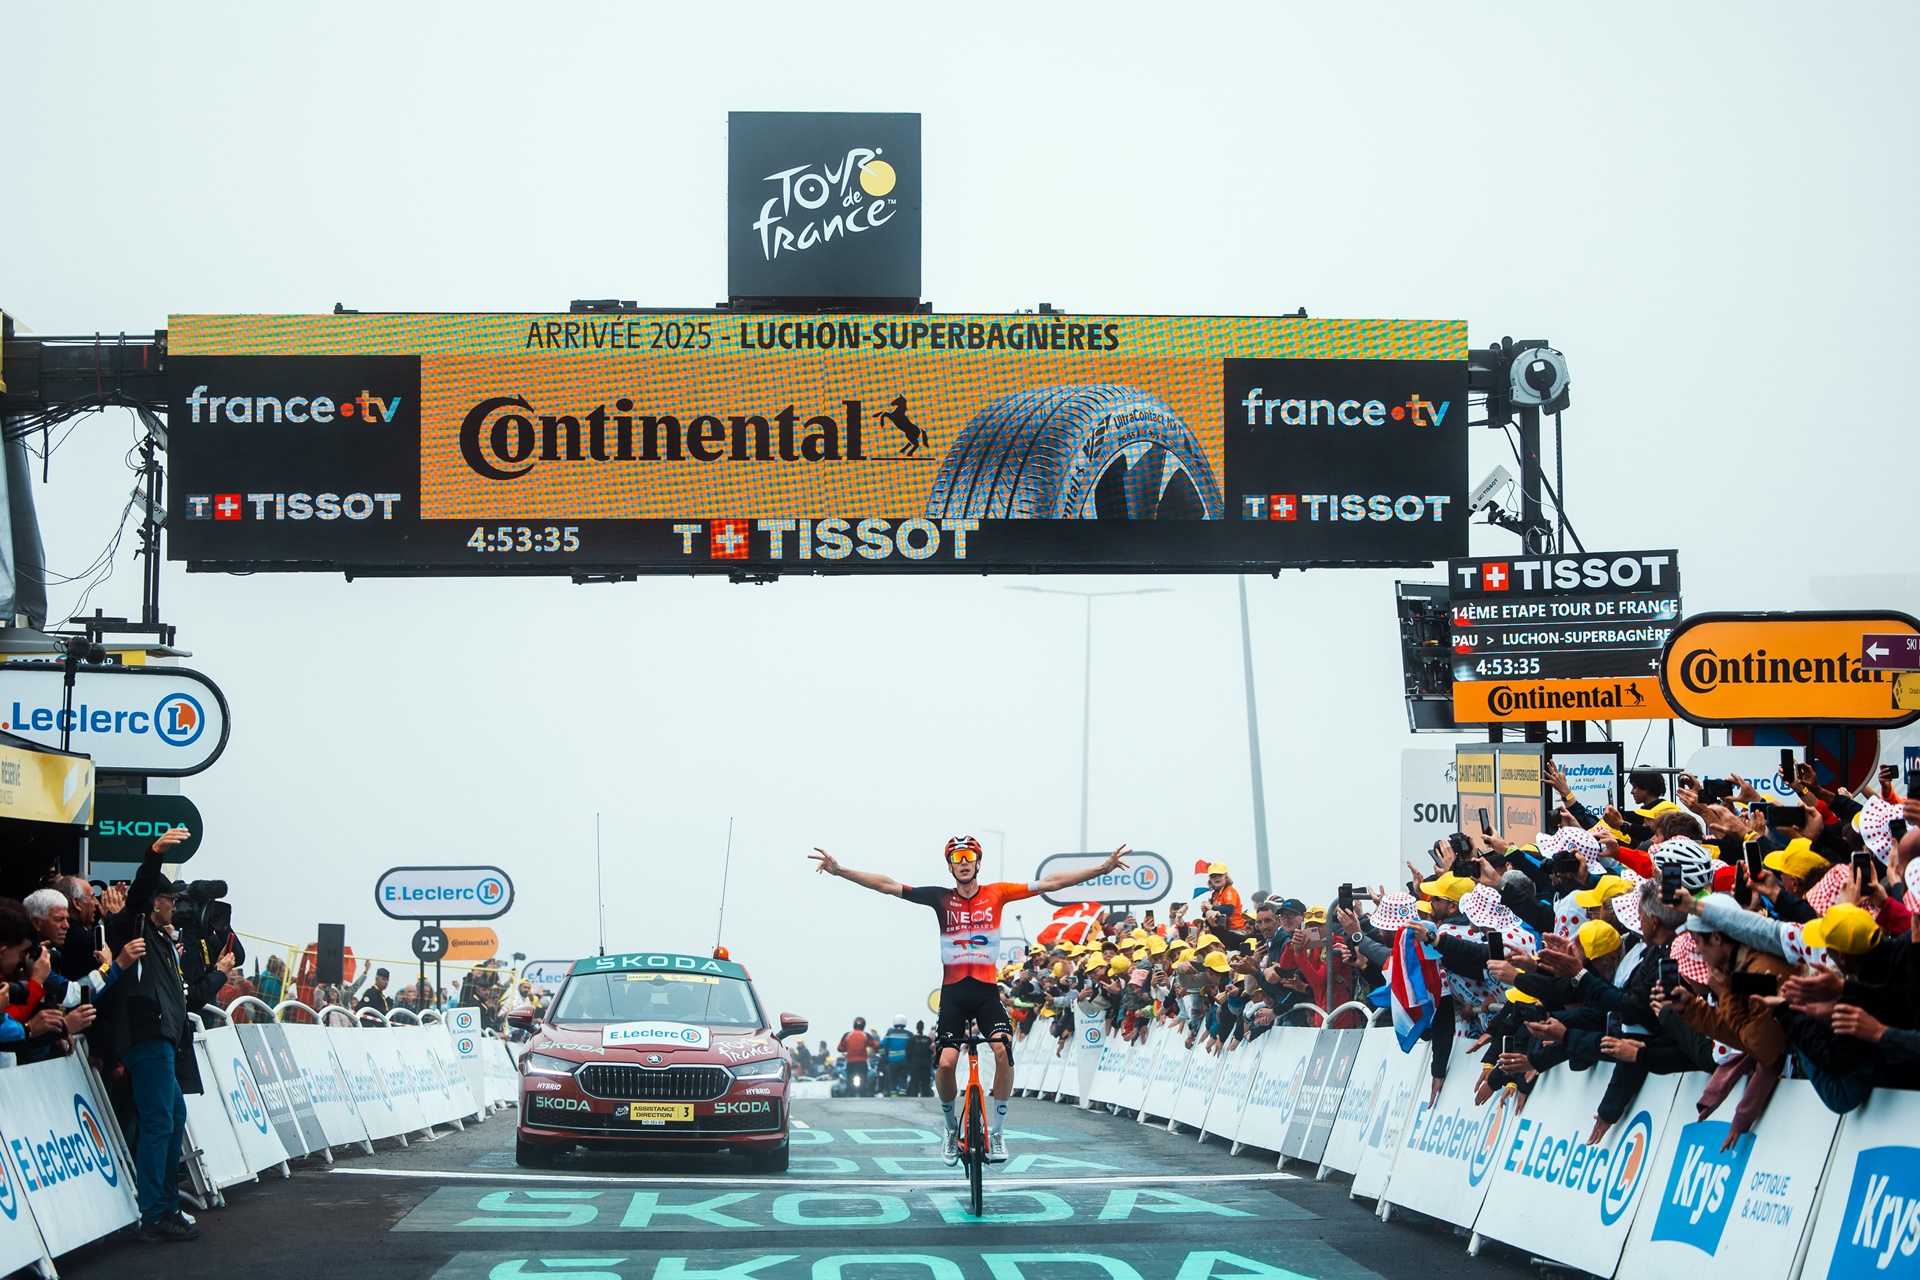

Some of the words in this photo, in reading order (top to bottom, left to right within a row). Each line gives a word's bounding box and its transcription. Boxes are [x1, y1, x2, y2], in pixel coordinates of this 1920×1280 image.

[842, 187, 863, 208] de
[526, 315, 641, 349] ARRIVÉE
[650, 322, 712, 350] 2025
[740, 317, 1119, 351] LUCHON-SUPERBAGNÈRES
[459, 393, 867, 481] Continental
[1482, 477, 1499, 495] TISSOT
[247, 493, 402, 520] TISSOT
[1302, 494, 1451, 521] TISSOT
[466, 526, 581, 552] 4:53:35
[758, 518, 980, 560] TISSOT
[1514, 556, 1669, 590] TISSOT
[1452, 603, 1499, 620] 14ÈME
[1502, 603, 1547, 618] ETAPE
[1551, 602, 1593, 617] TOUR
[1595, 601, 1615, 615] DE
[1619, 599, 1679, 614] FRANCE
[1451, 634, 1479, 647] PAU
[1475, 658, 1541, 676] 4:53:35
[1487, 684, 1624, 716] Continental
[385, 886, 475, 901] E.Leclerc
[946, 907, 993, 925] INEOS
[421, 936, 440, 952] 25
[451, 938, 490, 948] Continental
[610, 1029, 679, 1040] E.Leclerc
[537, 1082, 562, 1091] HYBRID
[746, 1087, 771, 1096] HYBRID
[683, 1107, 690, 1118] 3
[1407, 1100, 1480, 1163] E.Leclerc
[10, 1129, 94, 1193] E.Leclerc
[1503, 1117, 1610, 1195] E.Leclerc
[1672, 1143, 1732, 1226] Krys
[1750, 1171, 1791, 1197] OPTIQUE
[1741, 1198, 1750, 1219] &
[1749, 1201, 1794, 1227] AUDITION
[1851, 1173, 1920, 1270] Krys
